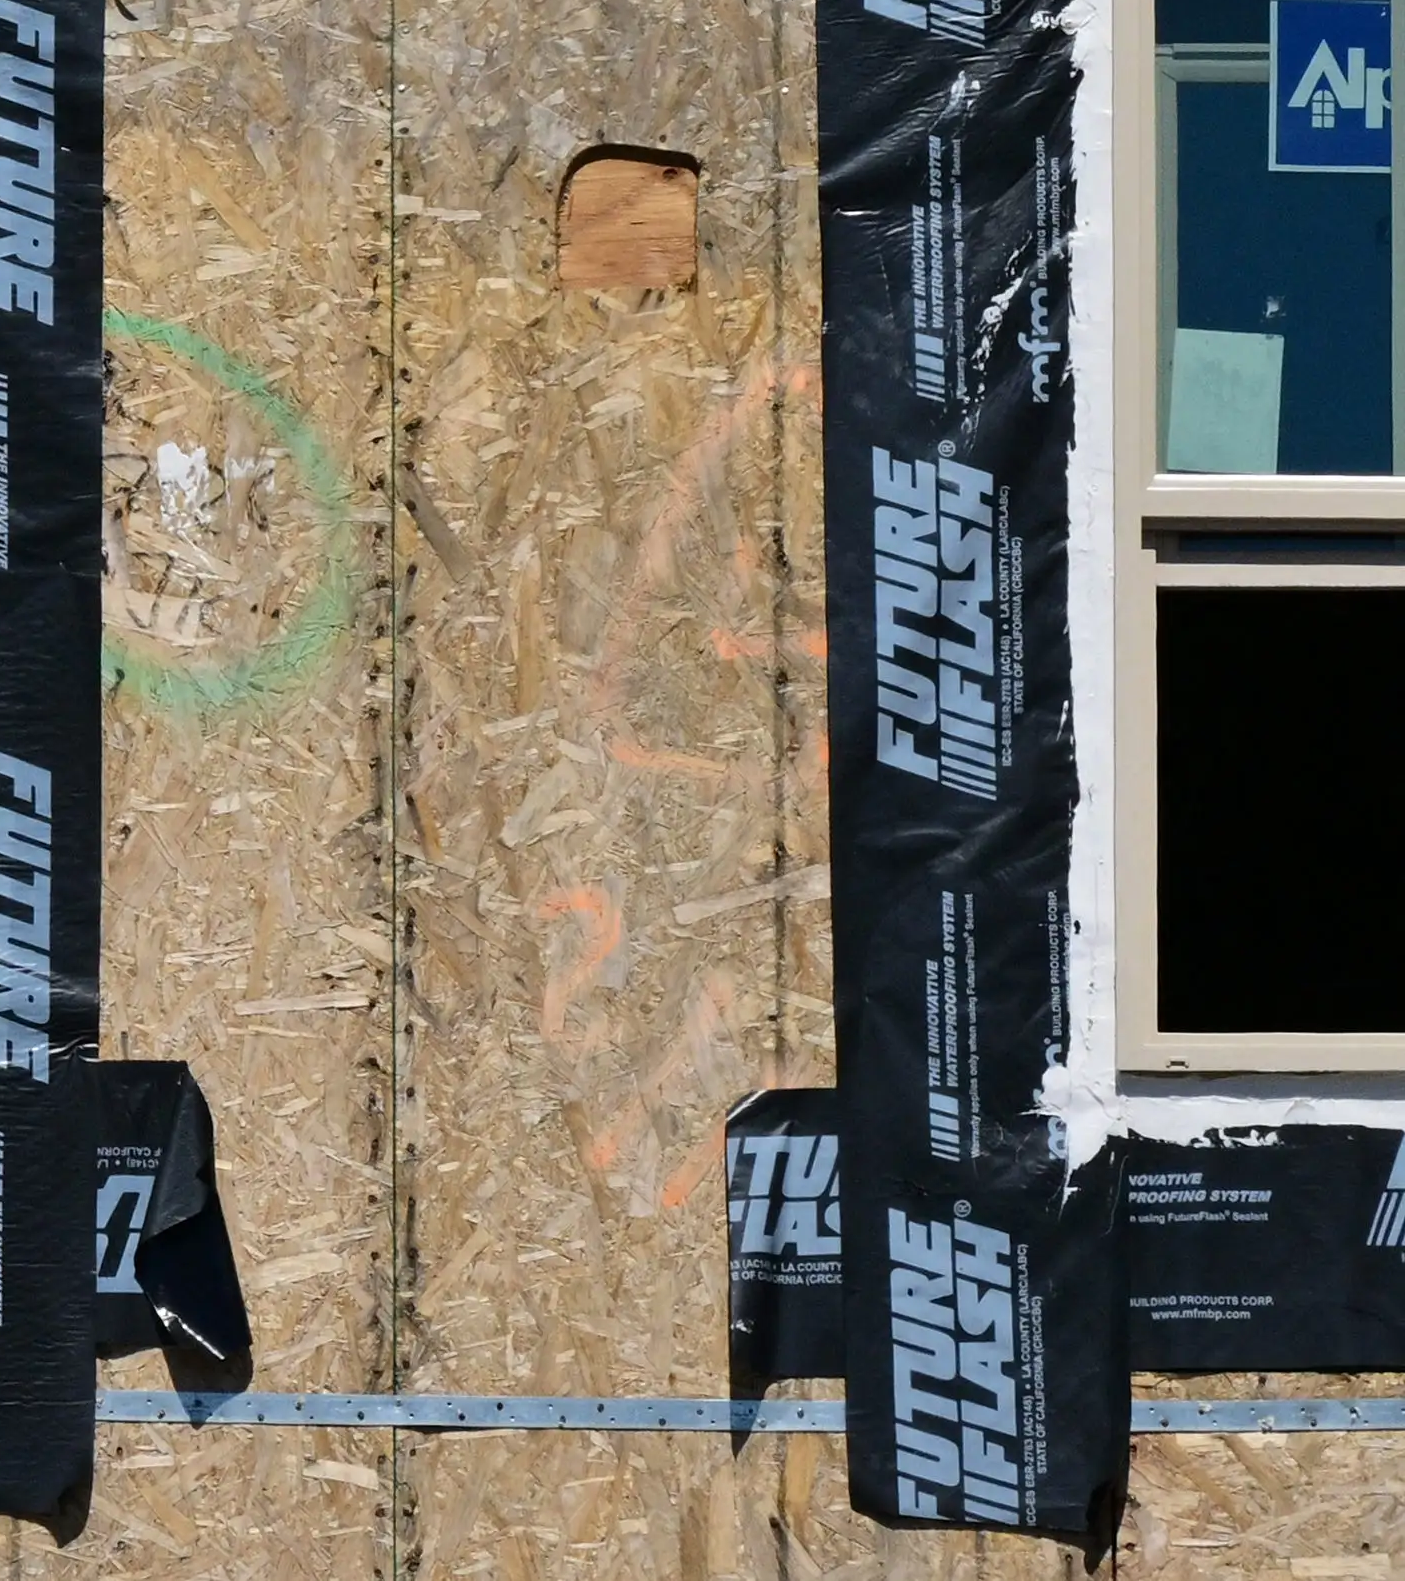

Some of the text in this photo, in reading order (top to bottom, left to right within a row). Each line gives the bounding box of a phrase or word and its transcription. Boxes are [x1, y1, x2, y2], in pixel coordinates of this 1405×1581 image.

[911, 204, 927, 328] THE INNOVATIVE
[930, 134, 943, 329] WATERPROOFING SYSTEM
[1035, 134, 1048, 280] BUILDING PRODUCTS CORP.
[1018, 287, 1061, 403] mfm
[872, 446, 940, 781] FUTURE
[925, 960, 942, 1087] THE INNOVATIVE
[942, 891, 960, 1088] WATERPROOFING SYSTEM
[1047, 889, 1062, 1037] BUILDING PRODUCTS CORP.
[1209, 1190, 1272, 1204] SYSTEM
[889, 1208, 961, 1519] FUTURE
[1179, 1295, 1239, 1307] PRODUCTS
[1240, 1295, 1275, 1307] CORP.
[1017, 1244, 1037, 1527] ICC-ES ESR-2783 (AC148) LA COUNTY (LARC/LABC)
[1031, 1295, 1048, 1475] STATE OF CALIFORNIA (CRC/CBC)
